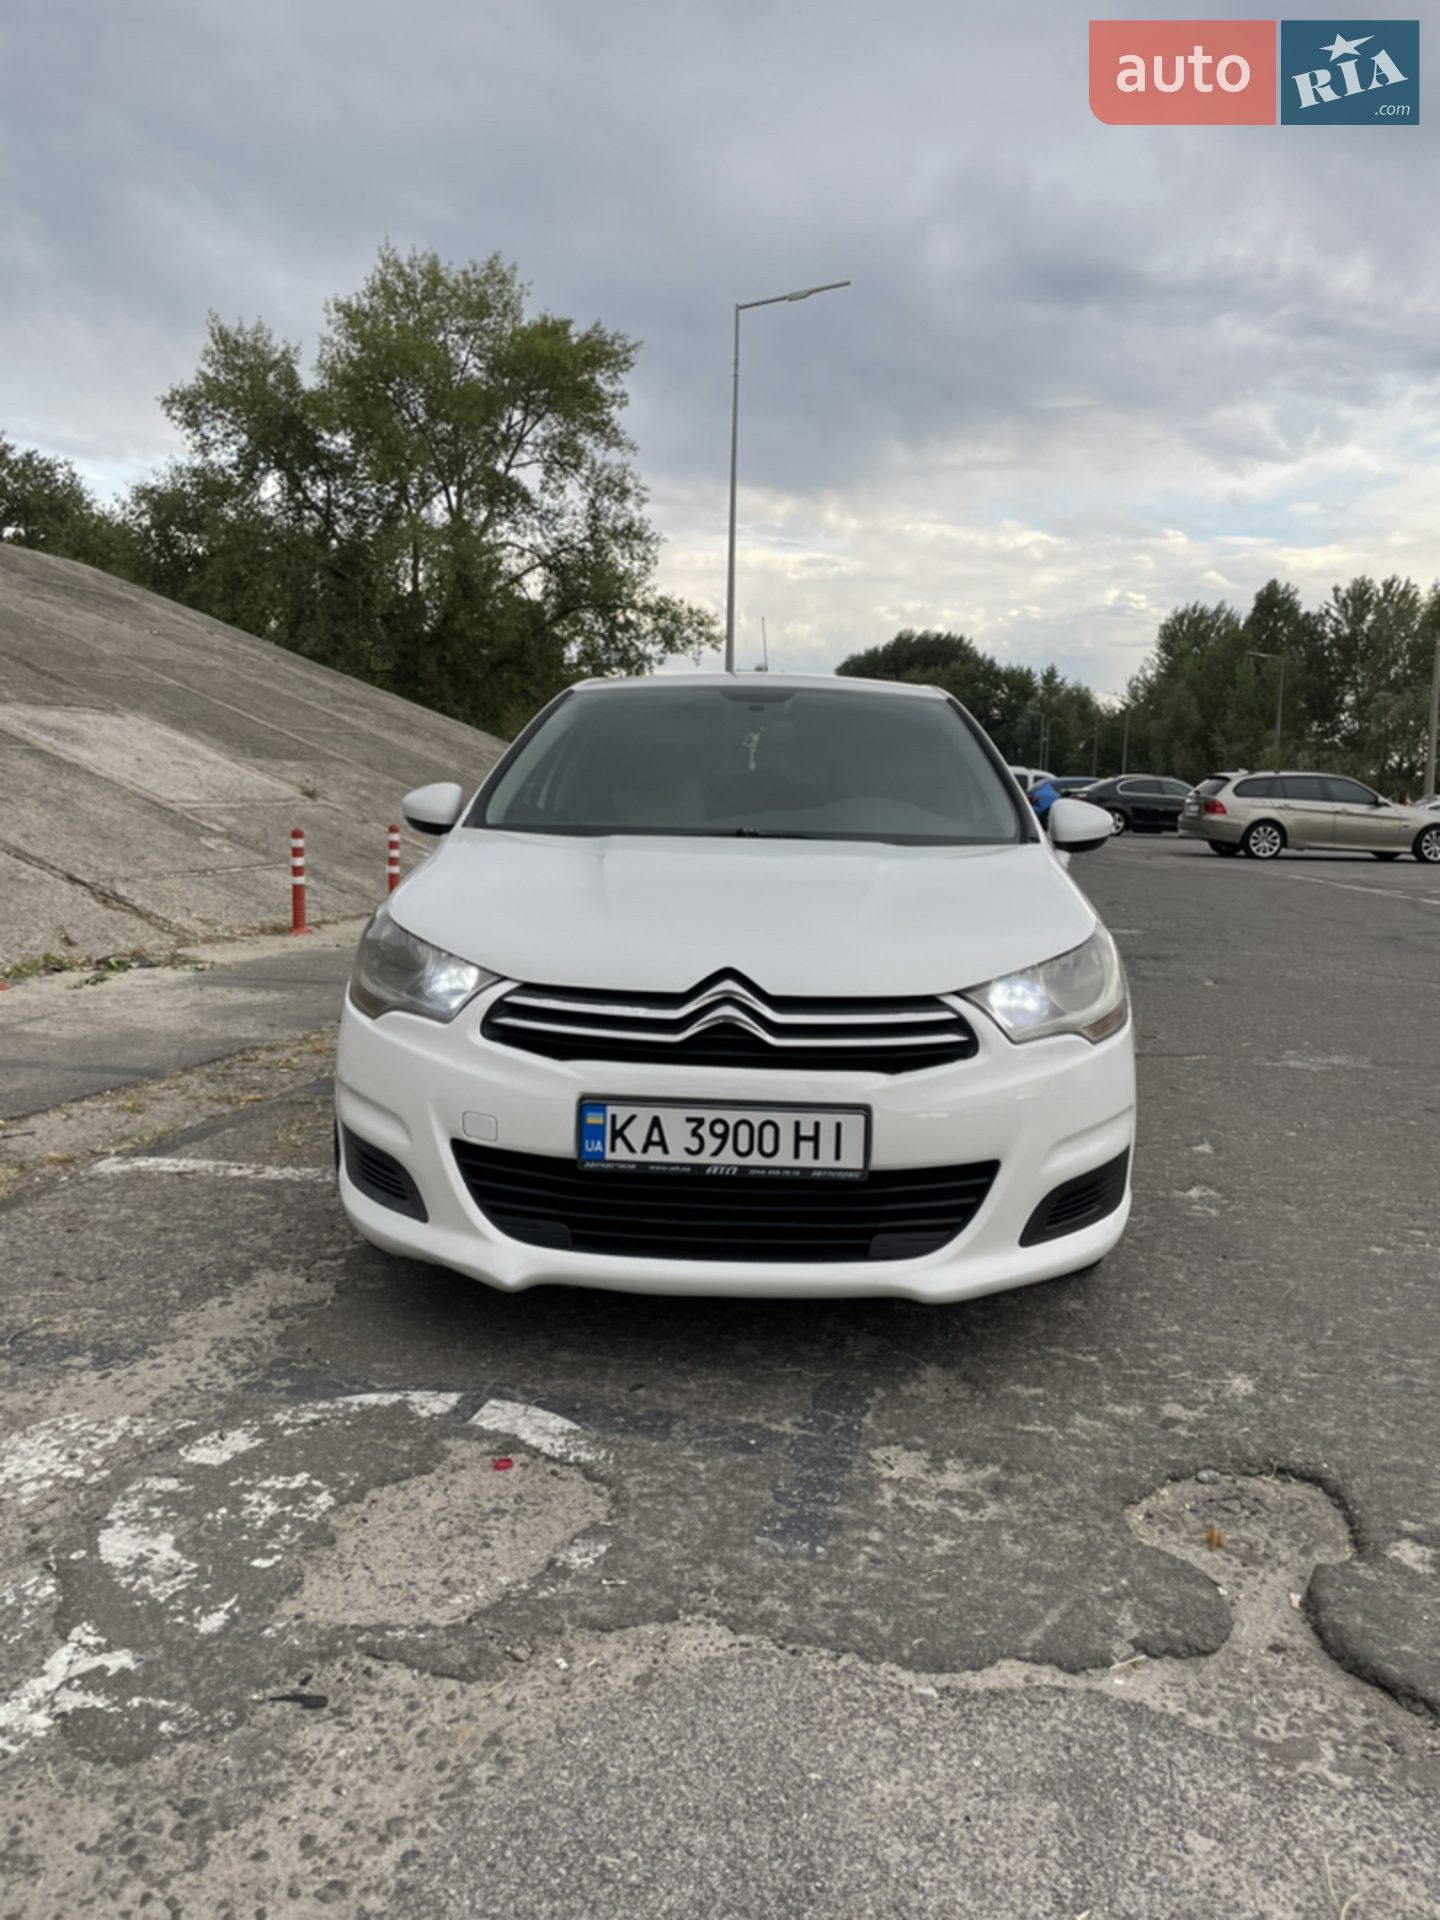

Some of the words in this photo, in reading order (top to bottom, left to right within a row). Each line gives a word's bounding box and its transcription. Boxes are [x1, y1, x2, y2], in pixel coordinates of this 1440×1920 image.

[584, 1139, 603, 1153] UA
[609, 1113, 670, 1156] KA
[683, 1116, 780, 1159] 3900
[793, 1120, 842, 1161] HI
